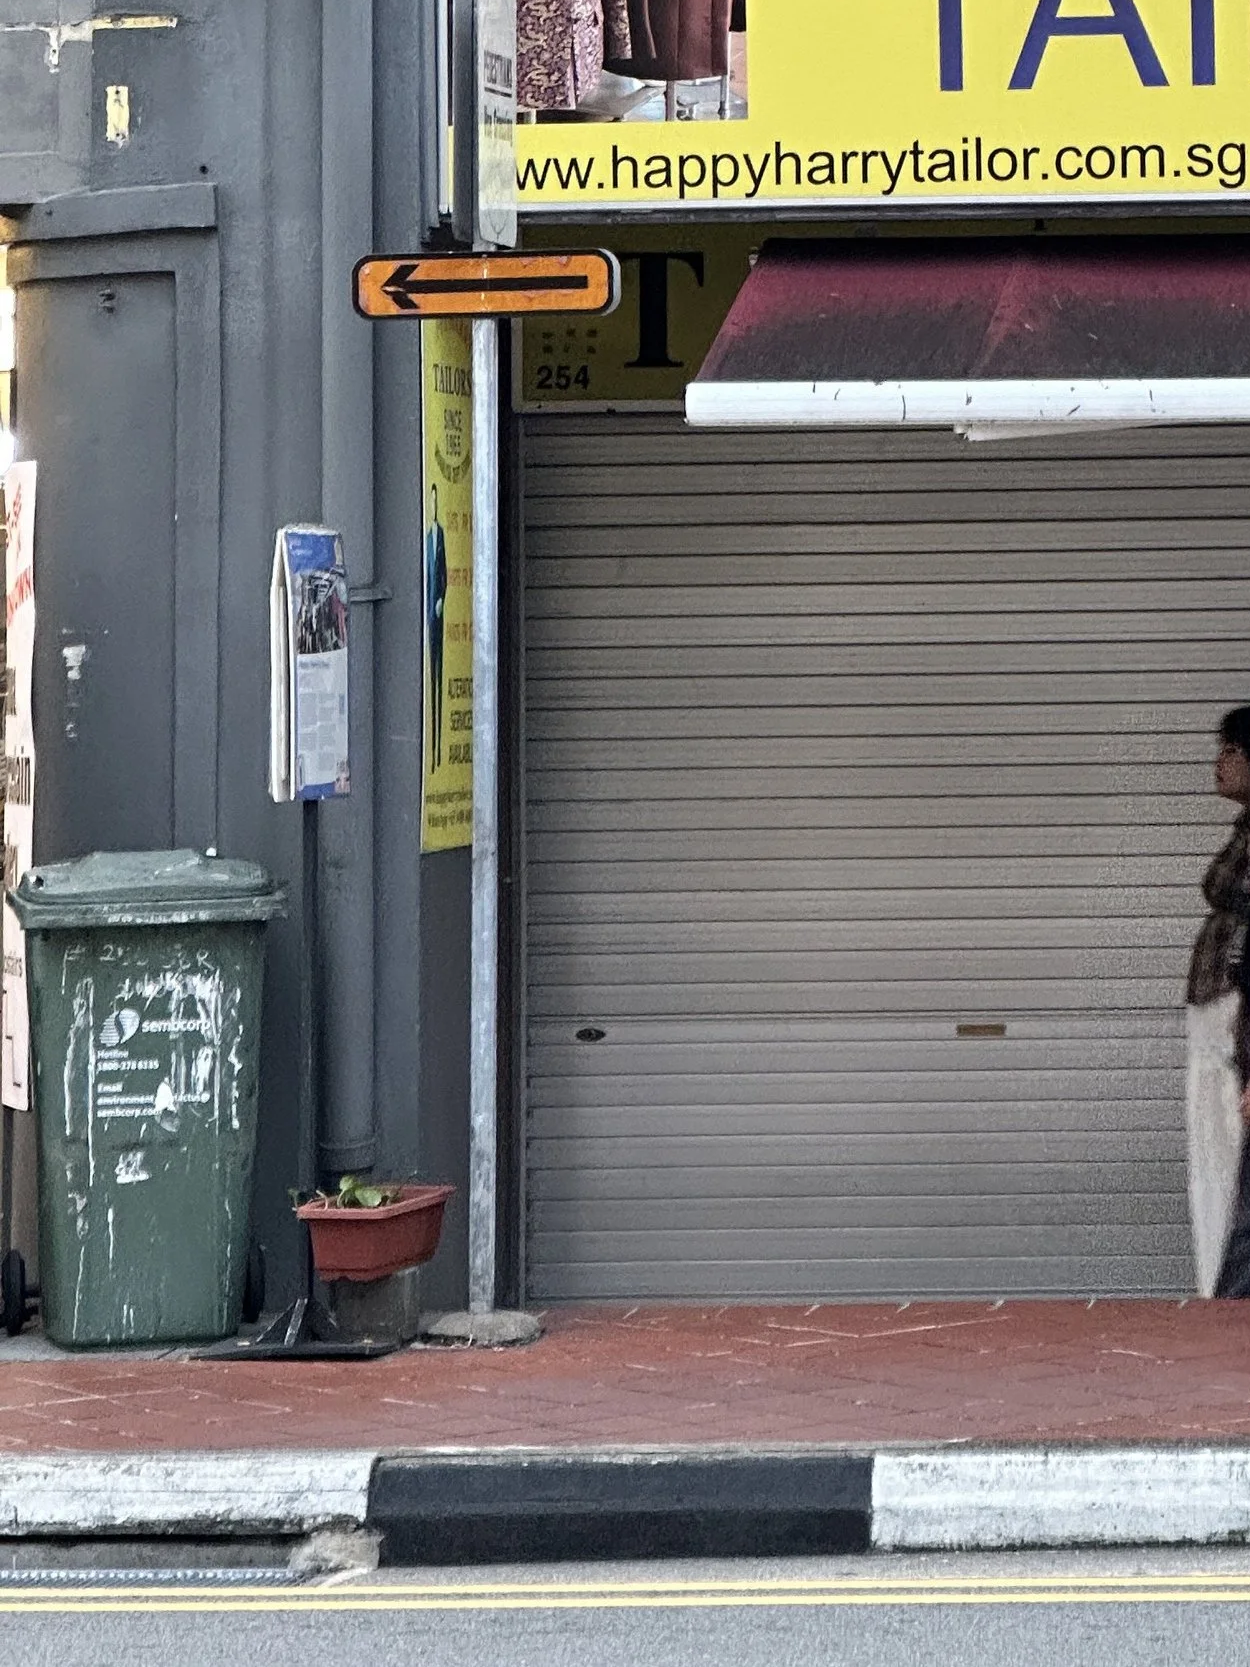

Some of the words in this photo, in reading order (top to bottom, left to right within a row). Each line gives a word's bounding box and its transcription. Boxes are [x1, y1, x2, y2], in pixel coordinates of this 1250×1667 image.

[516, 137, 1246, 198] ww.happyharrytailor.com.sg
[536, 365, 590, 390] 254
[141, 1018, 211, 1034] sembcorp
